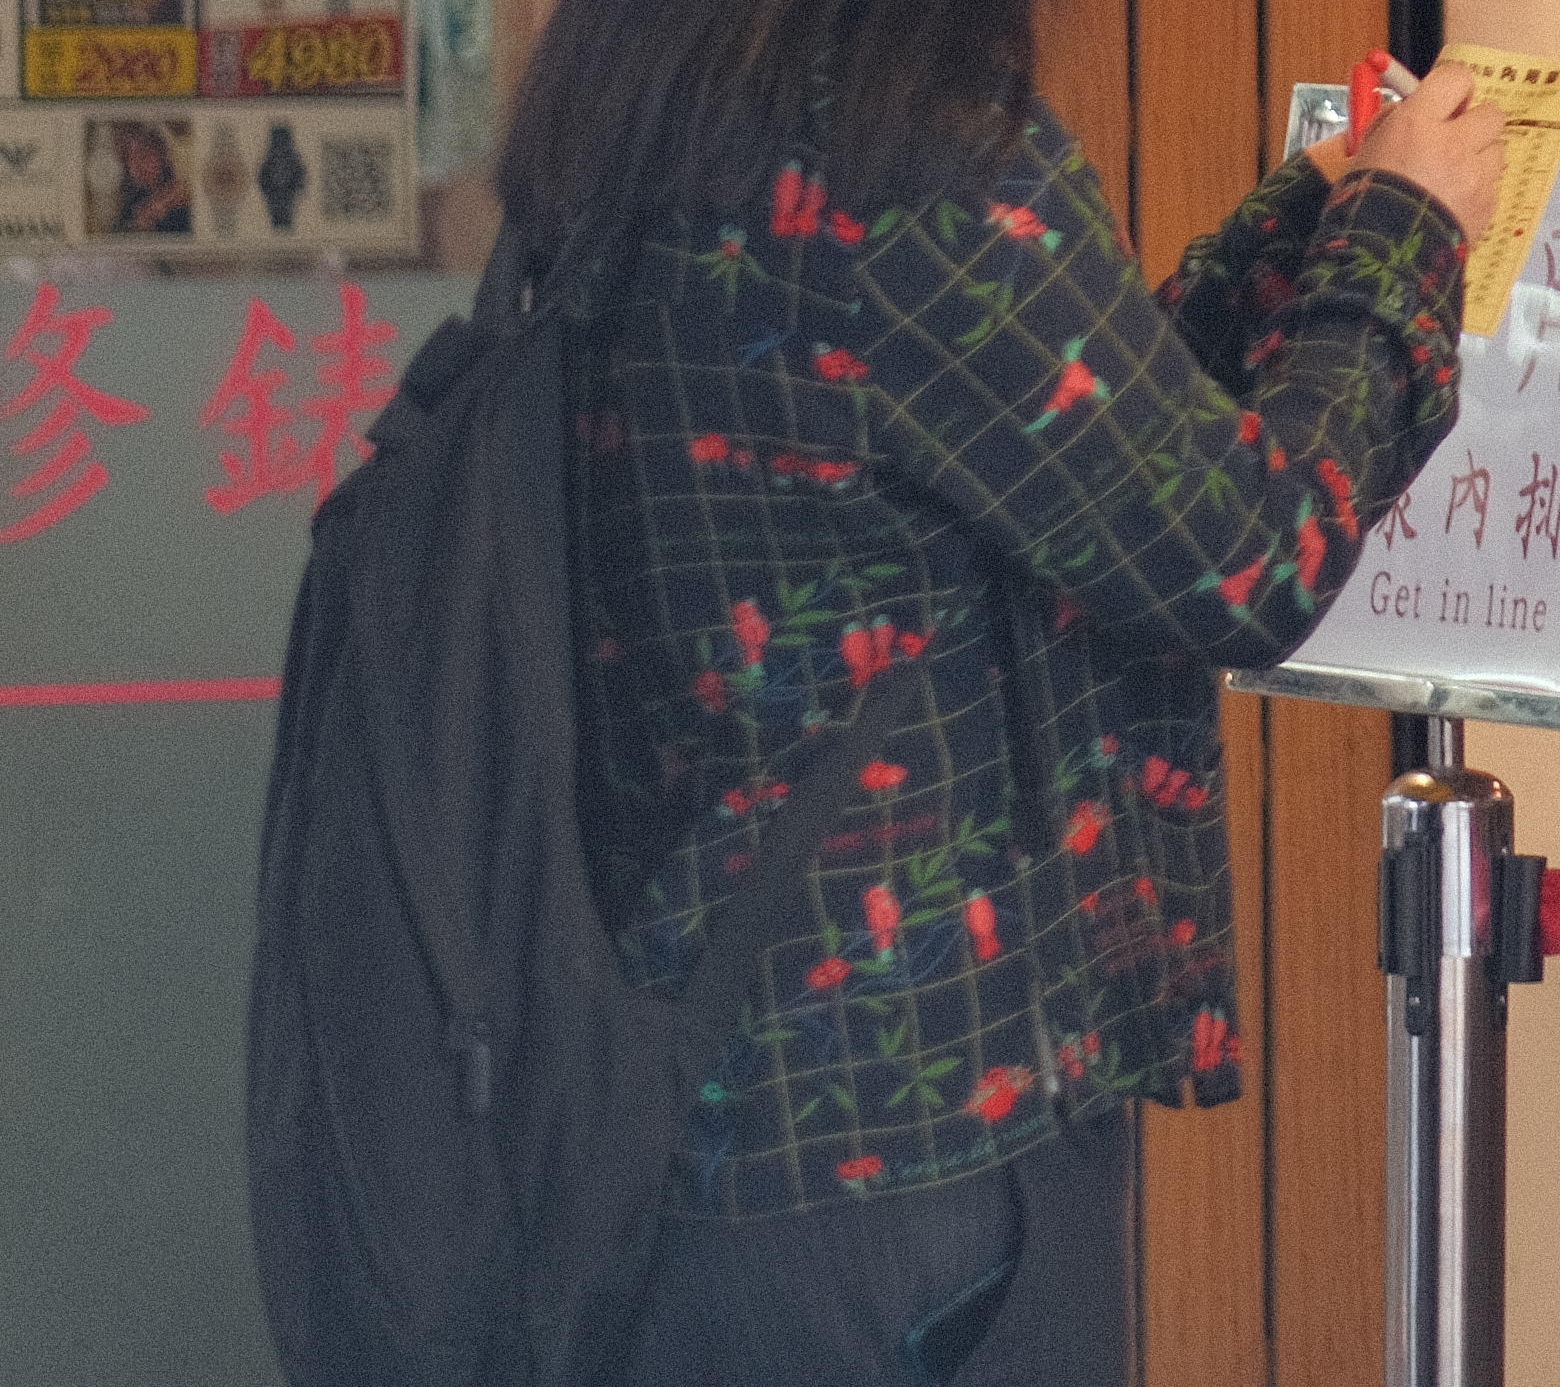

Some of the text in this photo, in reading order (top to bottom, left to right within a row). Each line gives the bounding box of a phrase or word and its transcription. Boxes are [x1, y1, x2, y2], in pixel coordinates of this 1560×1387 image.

[1368, 569, 1549, 634] Get in line
